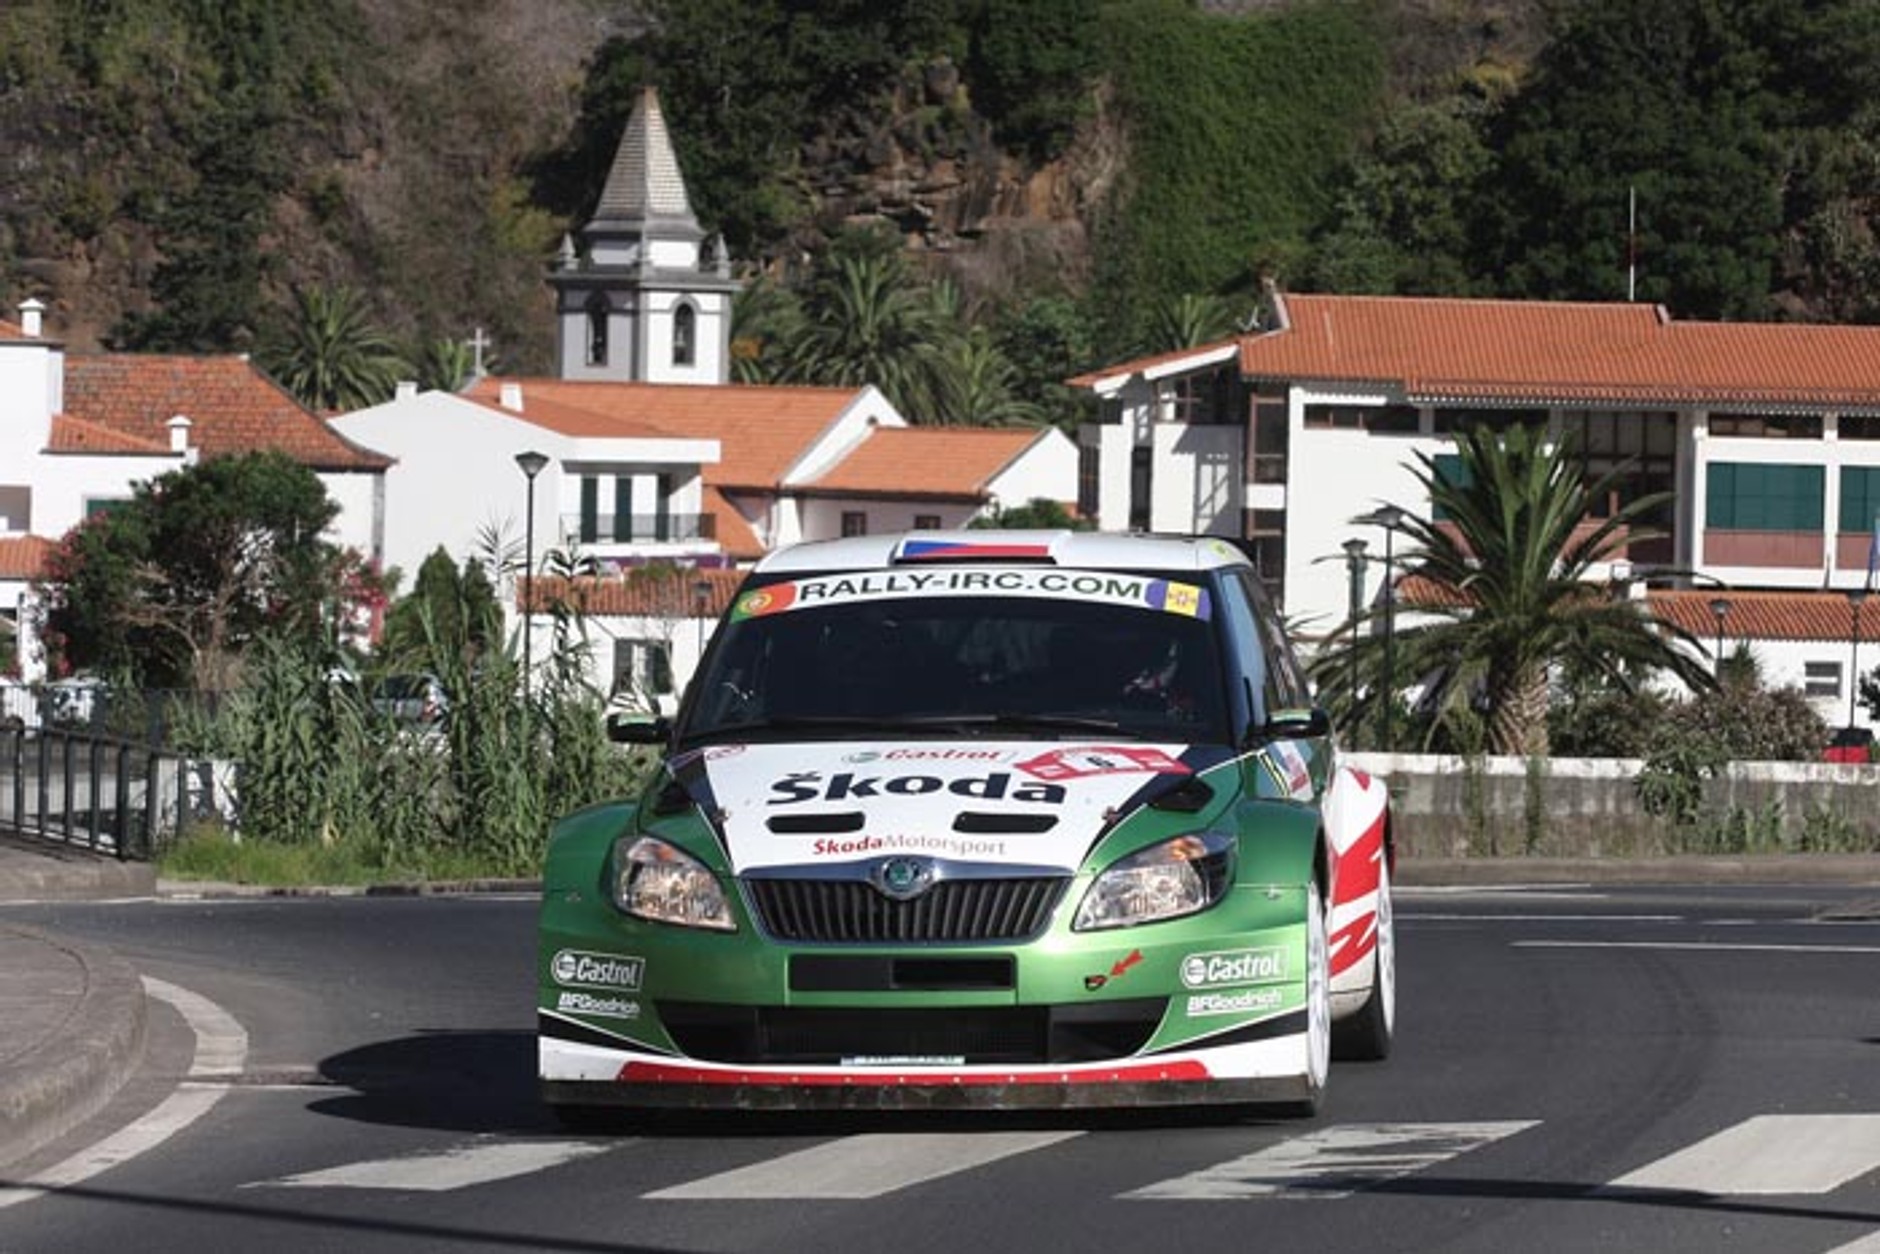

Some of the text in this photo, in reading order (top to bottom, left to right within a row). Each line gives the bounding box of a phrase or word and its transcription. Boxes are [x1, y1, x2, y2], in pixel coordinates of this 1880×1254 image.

[800, 572, 1142, 600] RALLY-IRC.COM
[766, 771, 1067, 805] Škoda
[577, 956, 638, 987] Castrol
[1208, 951, 1281, 981] Castrol
[558, 991, 641, 1016] BFGoodrich
[1187, 988, 1283, 1013] BFGoodrich
